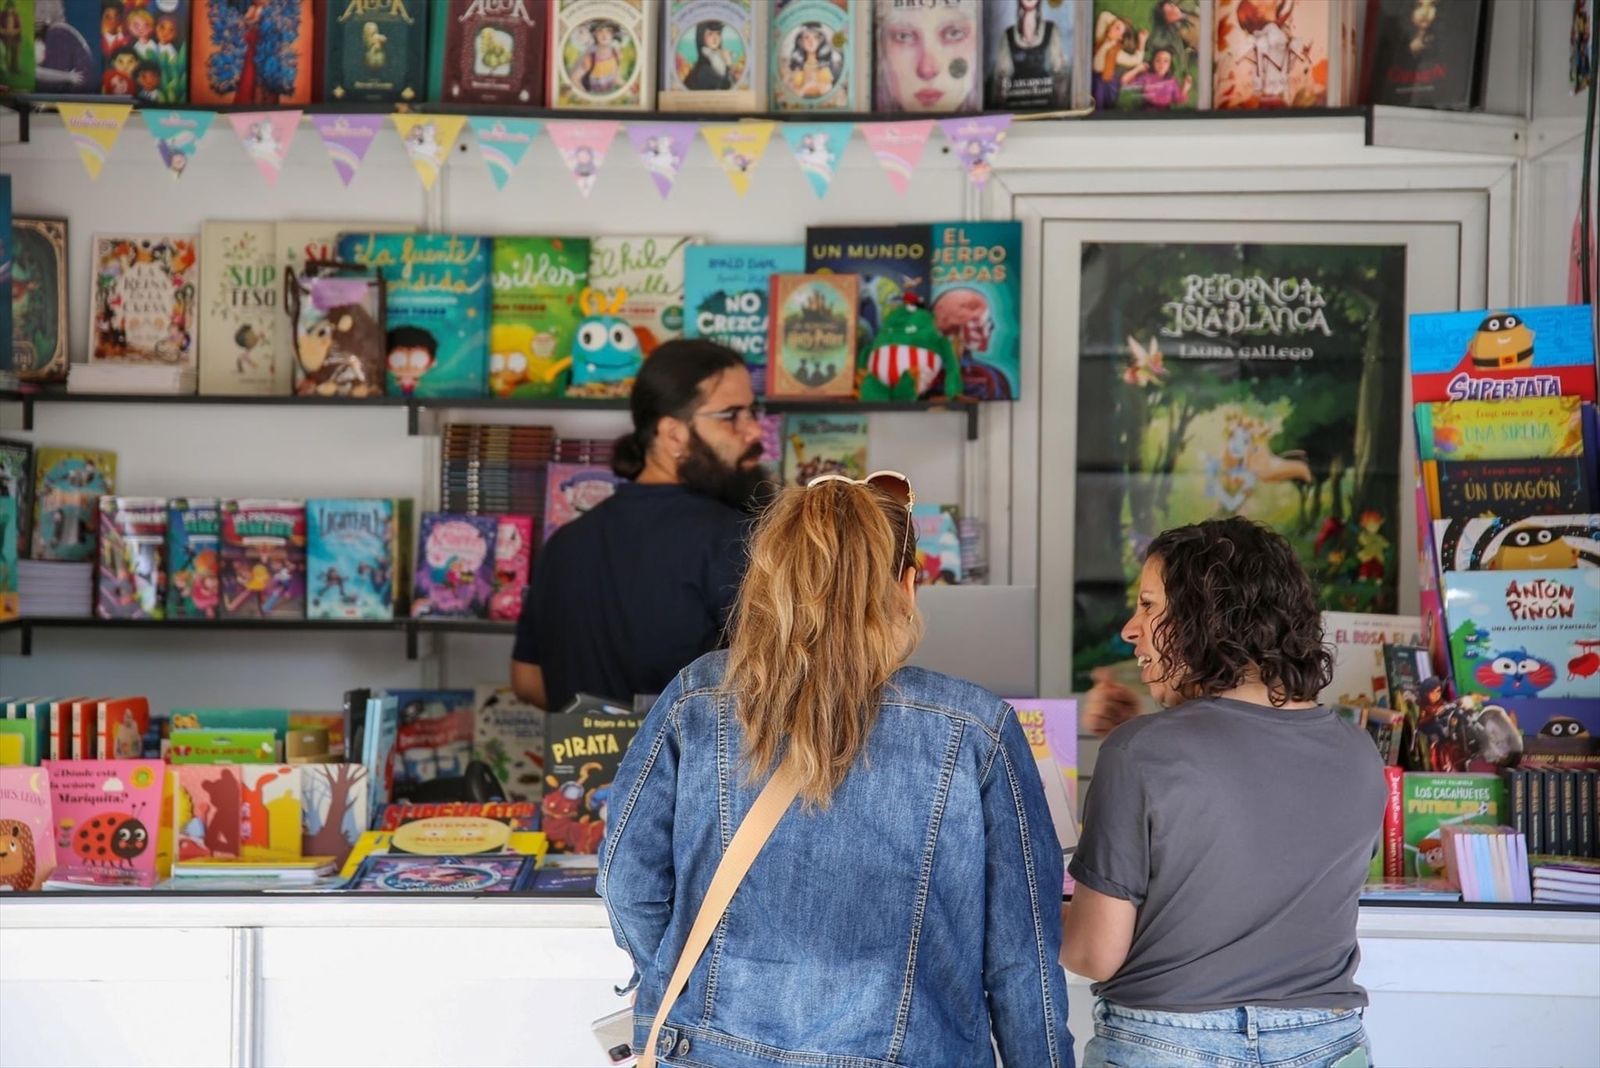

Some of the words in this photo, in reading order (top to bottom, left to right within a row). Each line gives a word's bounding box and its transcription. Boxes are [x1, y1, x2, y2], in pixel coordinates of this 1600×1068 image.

[944, 228, 970, 245] EL
[621, 237, 682, 273] hilo
[813, 244, 842, 259] UN
[848, 244, 924, 259] MUNDO
[931, 265, 1006, 282] CAPAS
[1183, 274, 1299, 306] RETORNO
[725, 292, 761, 314] NO
[1160, 302, 1224, 337] ISLA
[1225, 301, 1333, 336] BLANCA
[1180, 344, 1234, 360] LAURA
[1239, 345, 1314, 361] GALLEGO
[1447, 372, 1561, 401] SUPERTATA
[1464, 425, 1497, 442] UNA
[1501, 422, 1552, 441] SIRENA
[1465, 482, 1487, 500] UN
[1493, 478, 1561, 501] DRAGÓN
[1506, 579, 1575, 599] ANTÓN
[552, 733, 619, 763] PIRATA
[59, 793, 128, 805] Mariquita?
[1415, 785, 1433, 799] LOS
[1434, 786, 1490, 801] CACAHUETES
